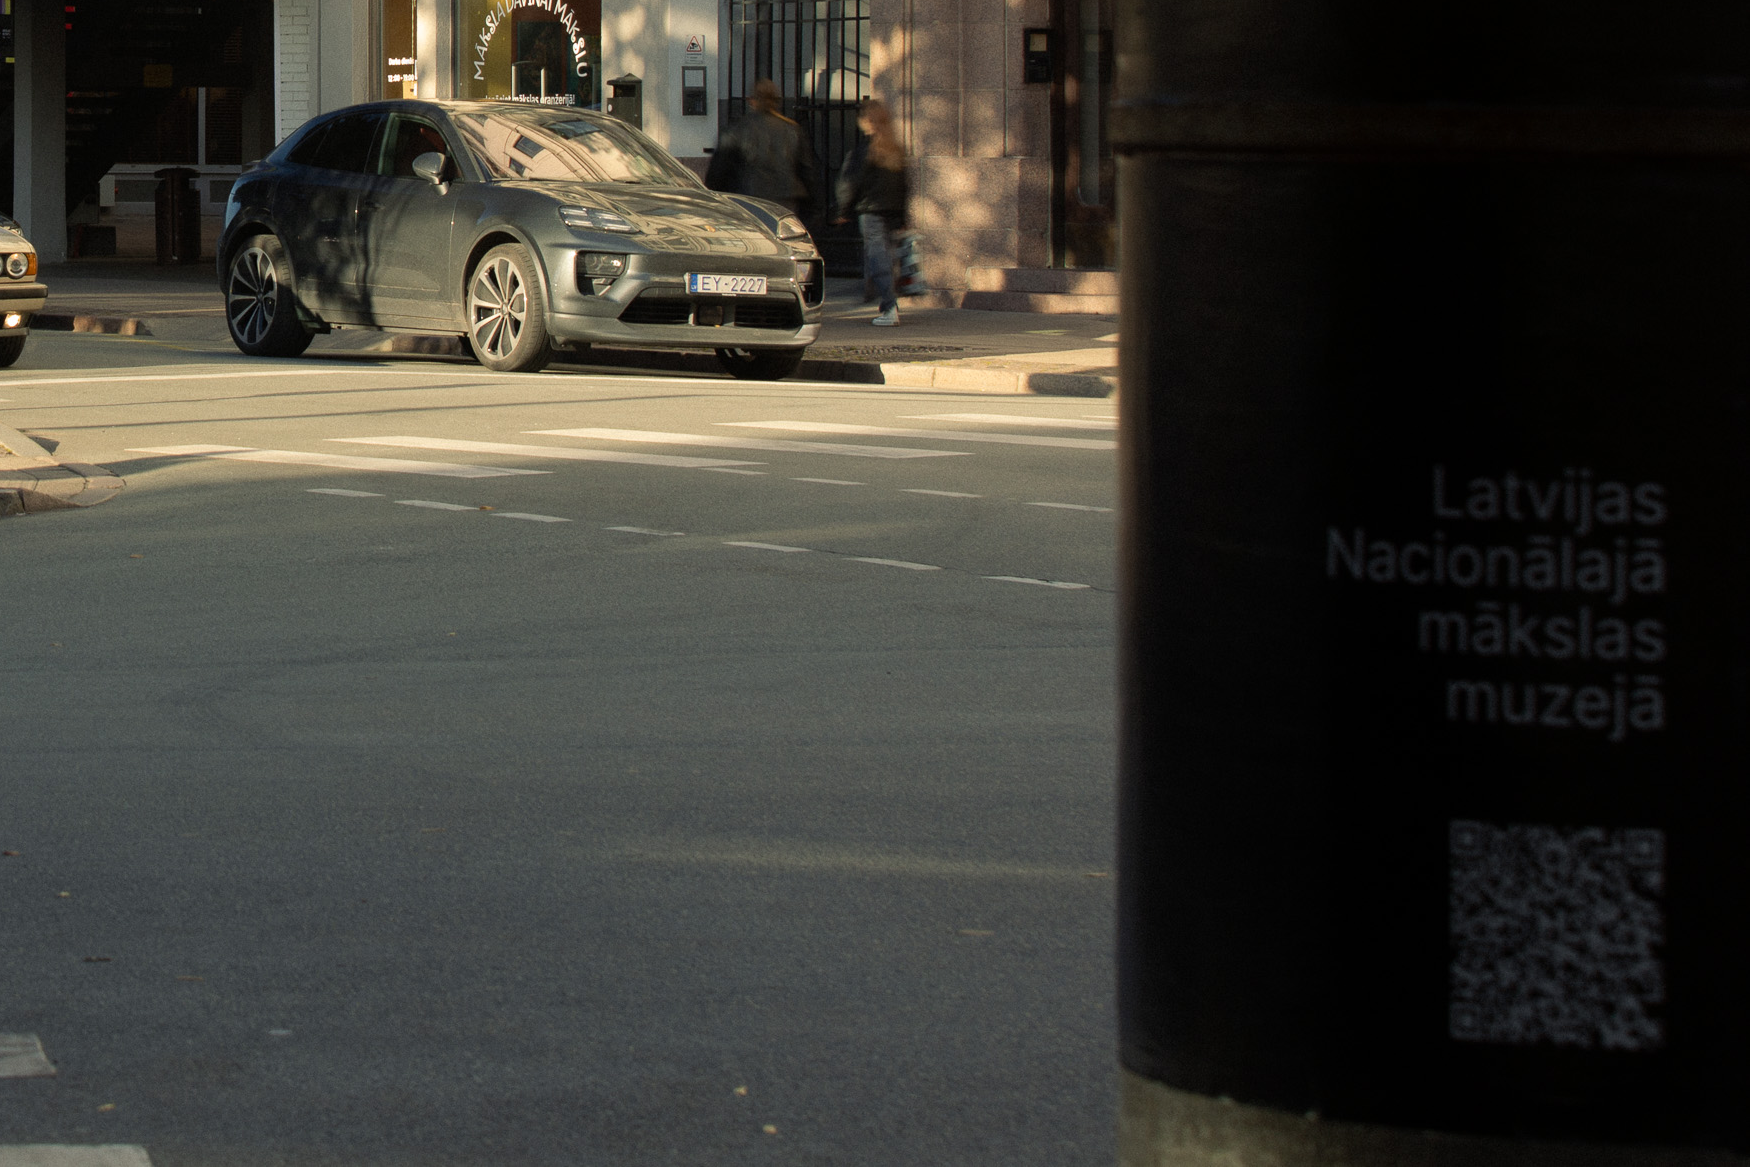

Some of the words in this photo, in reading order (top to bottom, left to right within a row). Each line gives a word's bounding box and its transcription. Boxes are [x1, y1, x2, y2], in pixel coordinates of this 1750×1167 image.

[473, 1, 506, 81] MĀKSLA
[701, 276, 765, 293] EY-2227
[1432, 464, 1668, 537] Latvijas
[1325, 525, 1666, 603] Nacionālajā
[1418, 602, 1665, 662] mākslas
[1445, 676, 1665, 742] muzejā
